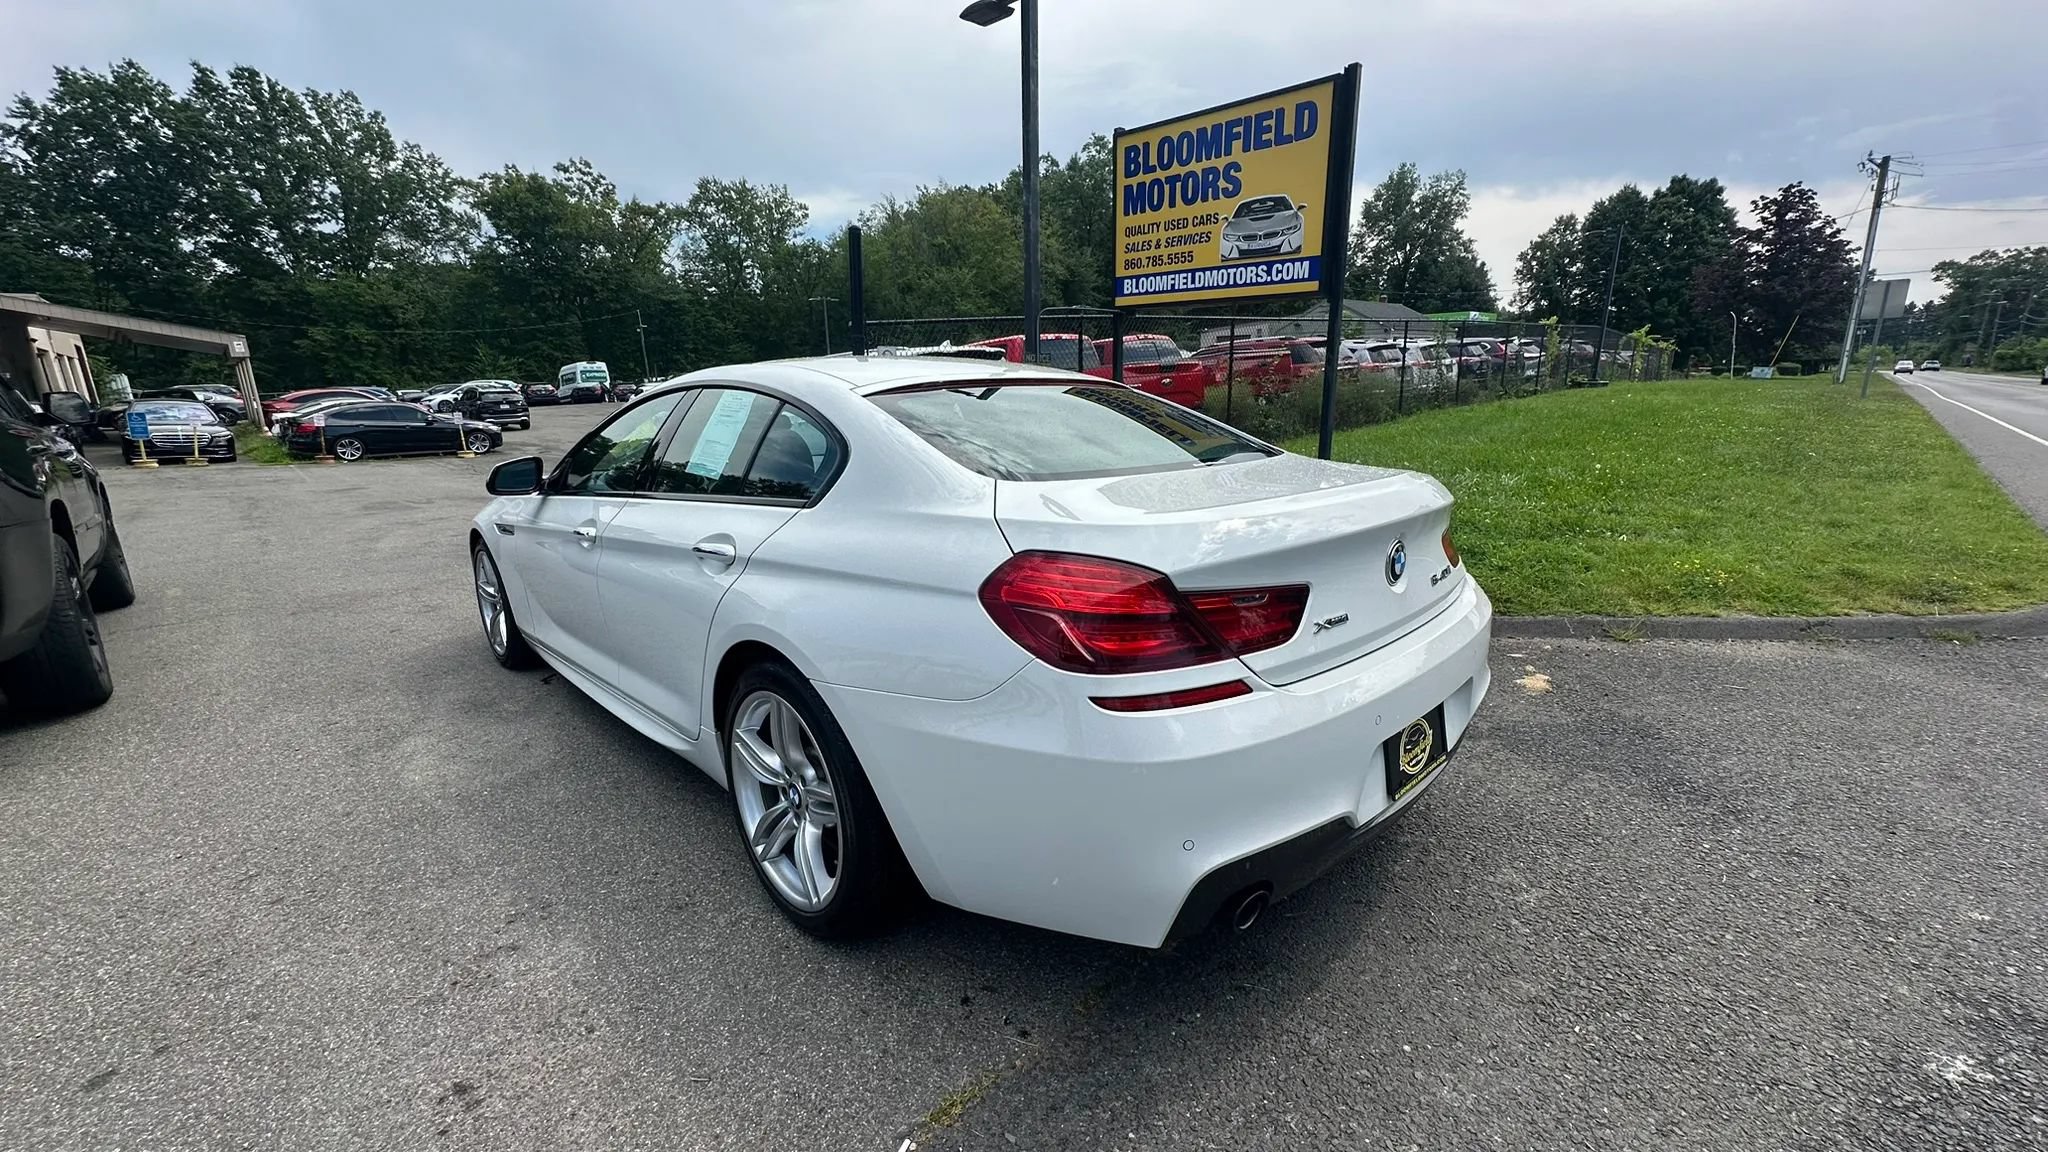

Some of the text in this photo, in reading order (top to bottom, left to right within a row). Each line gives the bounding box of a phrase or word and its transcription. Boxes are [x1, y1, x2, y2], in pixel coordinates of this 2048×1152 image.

[1124, 100, 1318, 179] BLOOMFIELD
[1123, 161, 1242, 217] MOTORS
[1124, 212, 1220, 238] QUALITY USED CARS
[1124, 231, 1212, 254] SALES & SERVICES
[1123, 251, 1194, 271] 860.785.5555
[1123, 261, 1310, 295] BLOOMFIELDMOTORS.COM
